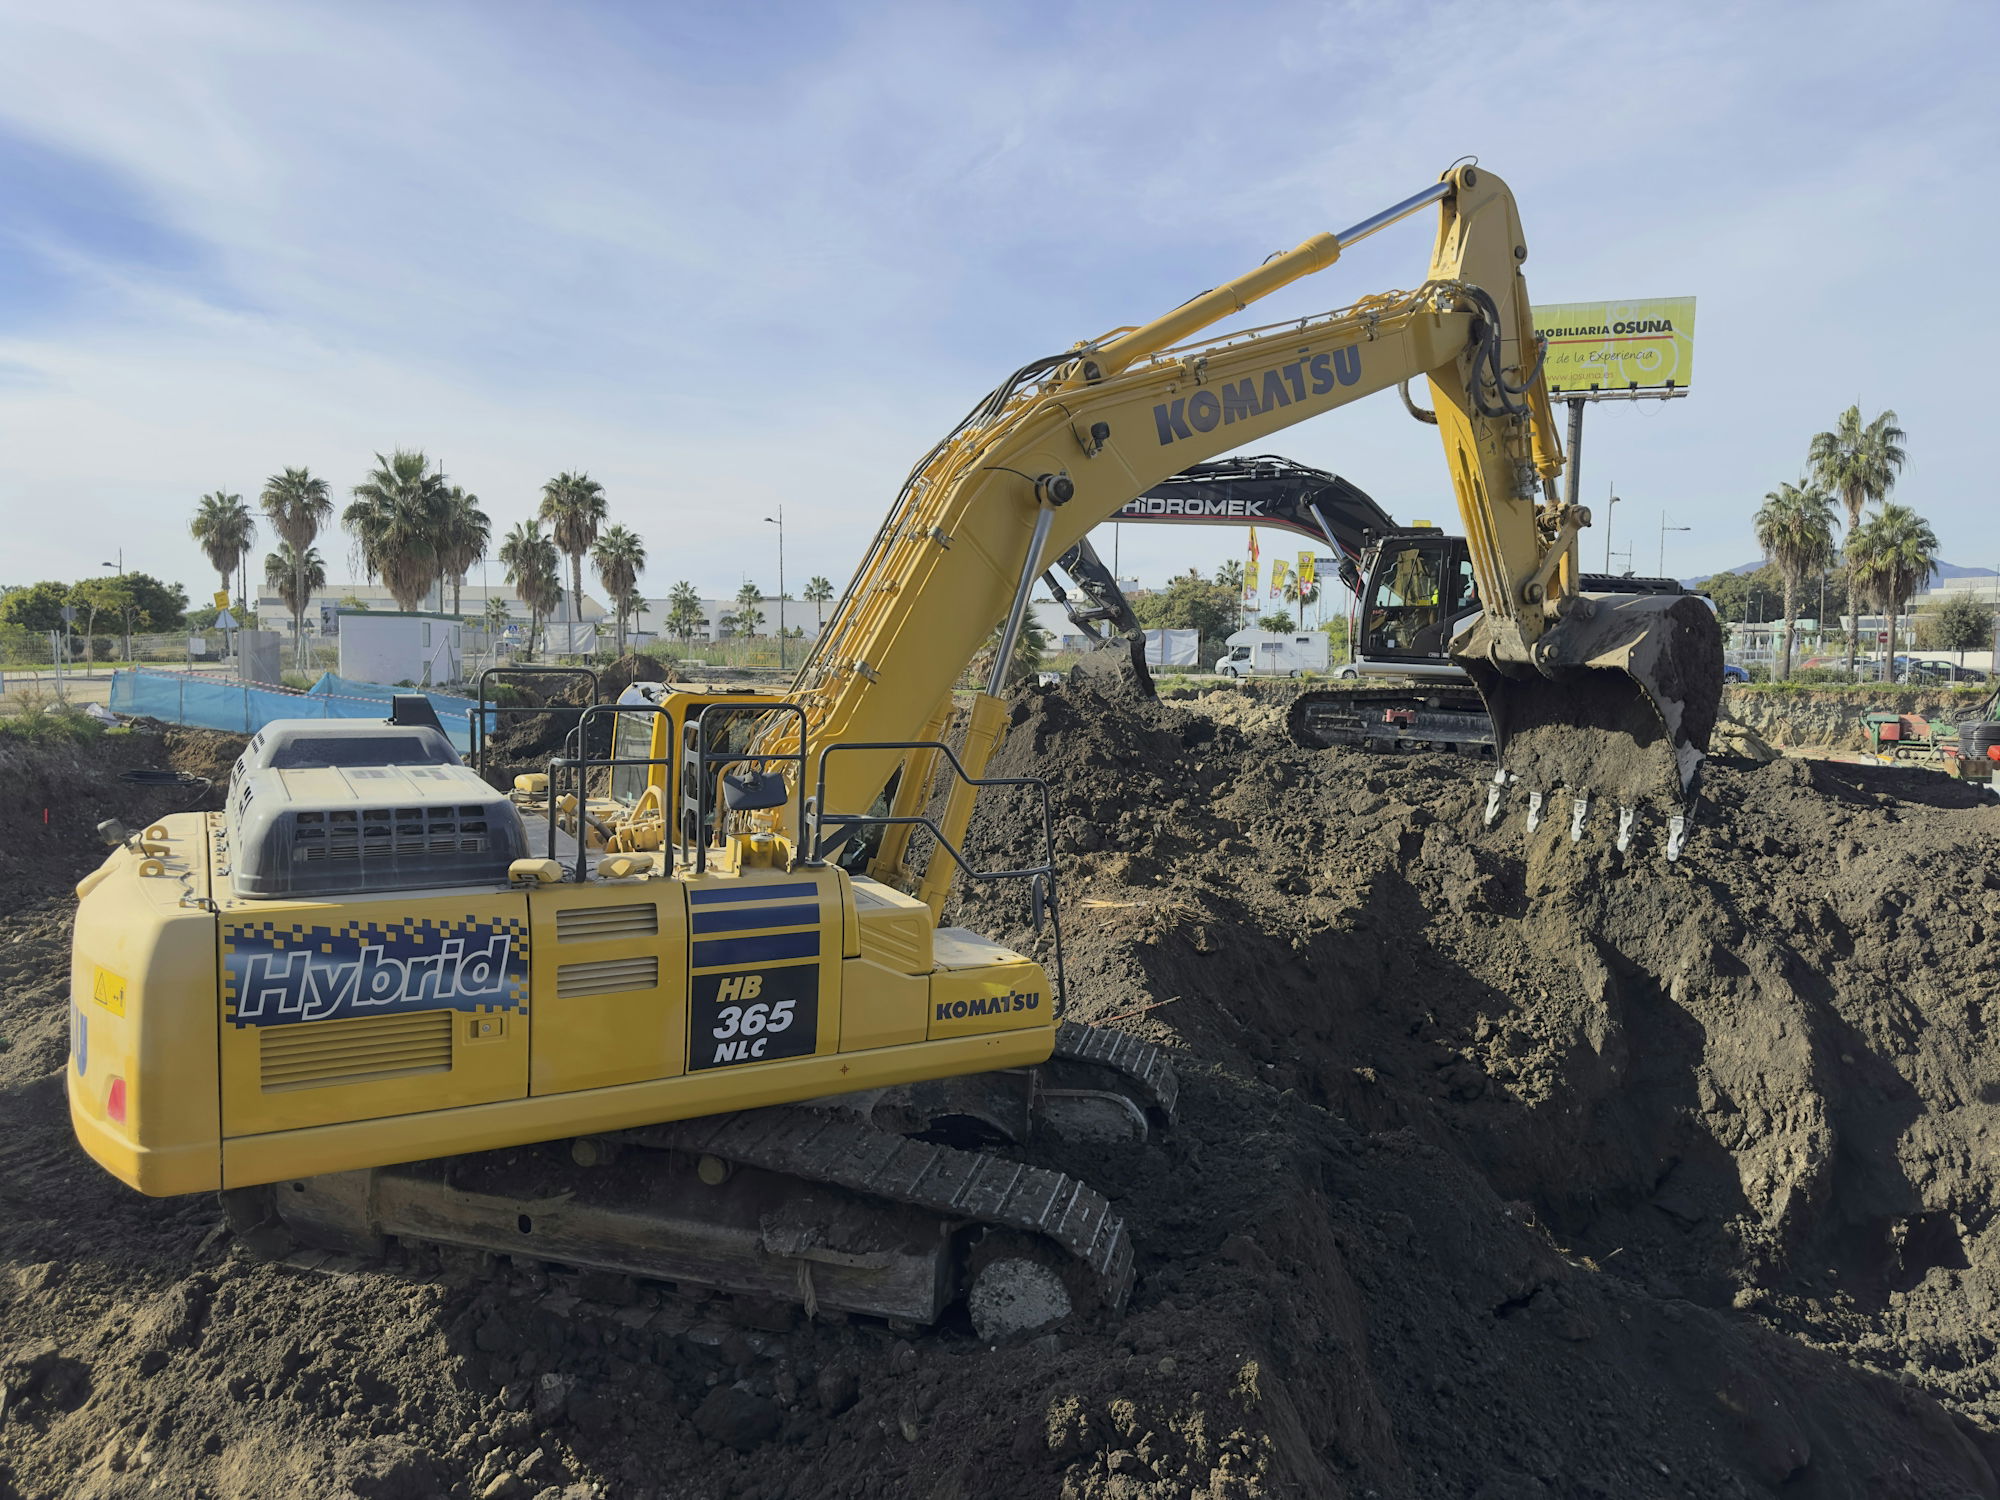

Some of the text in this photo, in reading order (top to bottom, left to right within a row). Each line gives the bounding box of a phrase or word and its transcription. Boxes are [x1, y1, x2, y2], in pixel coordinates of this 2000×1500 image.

[1612, 320, 1673, 334] OSUNA
[1153, 344, 1362, 446] KOMATSU
[237, 935, 511, 1021] Hybrid
[716, 975, 763, 1003] HB
[712, 1000, 797, 1040] 365
[936, 990, 1040, 1021] KOMATSU
[712, 1037, 768, 1064] NLC
